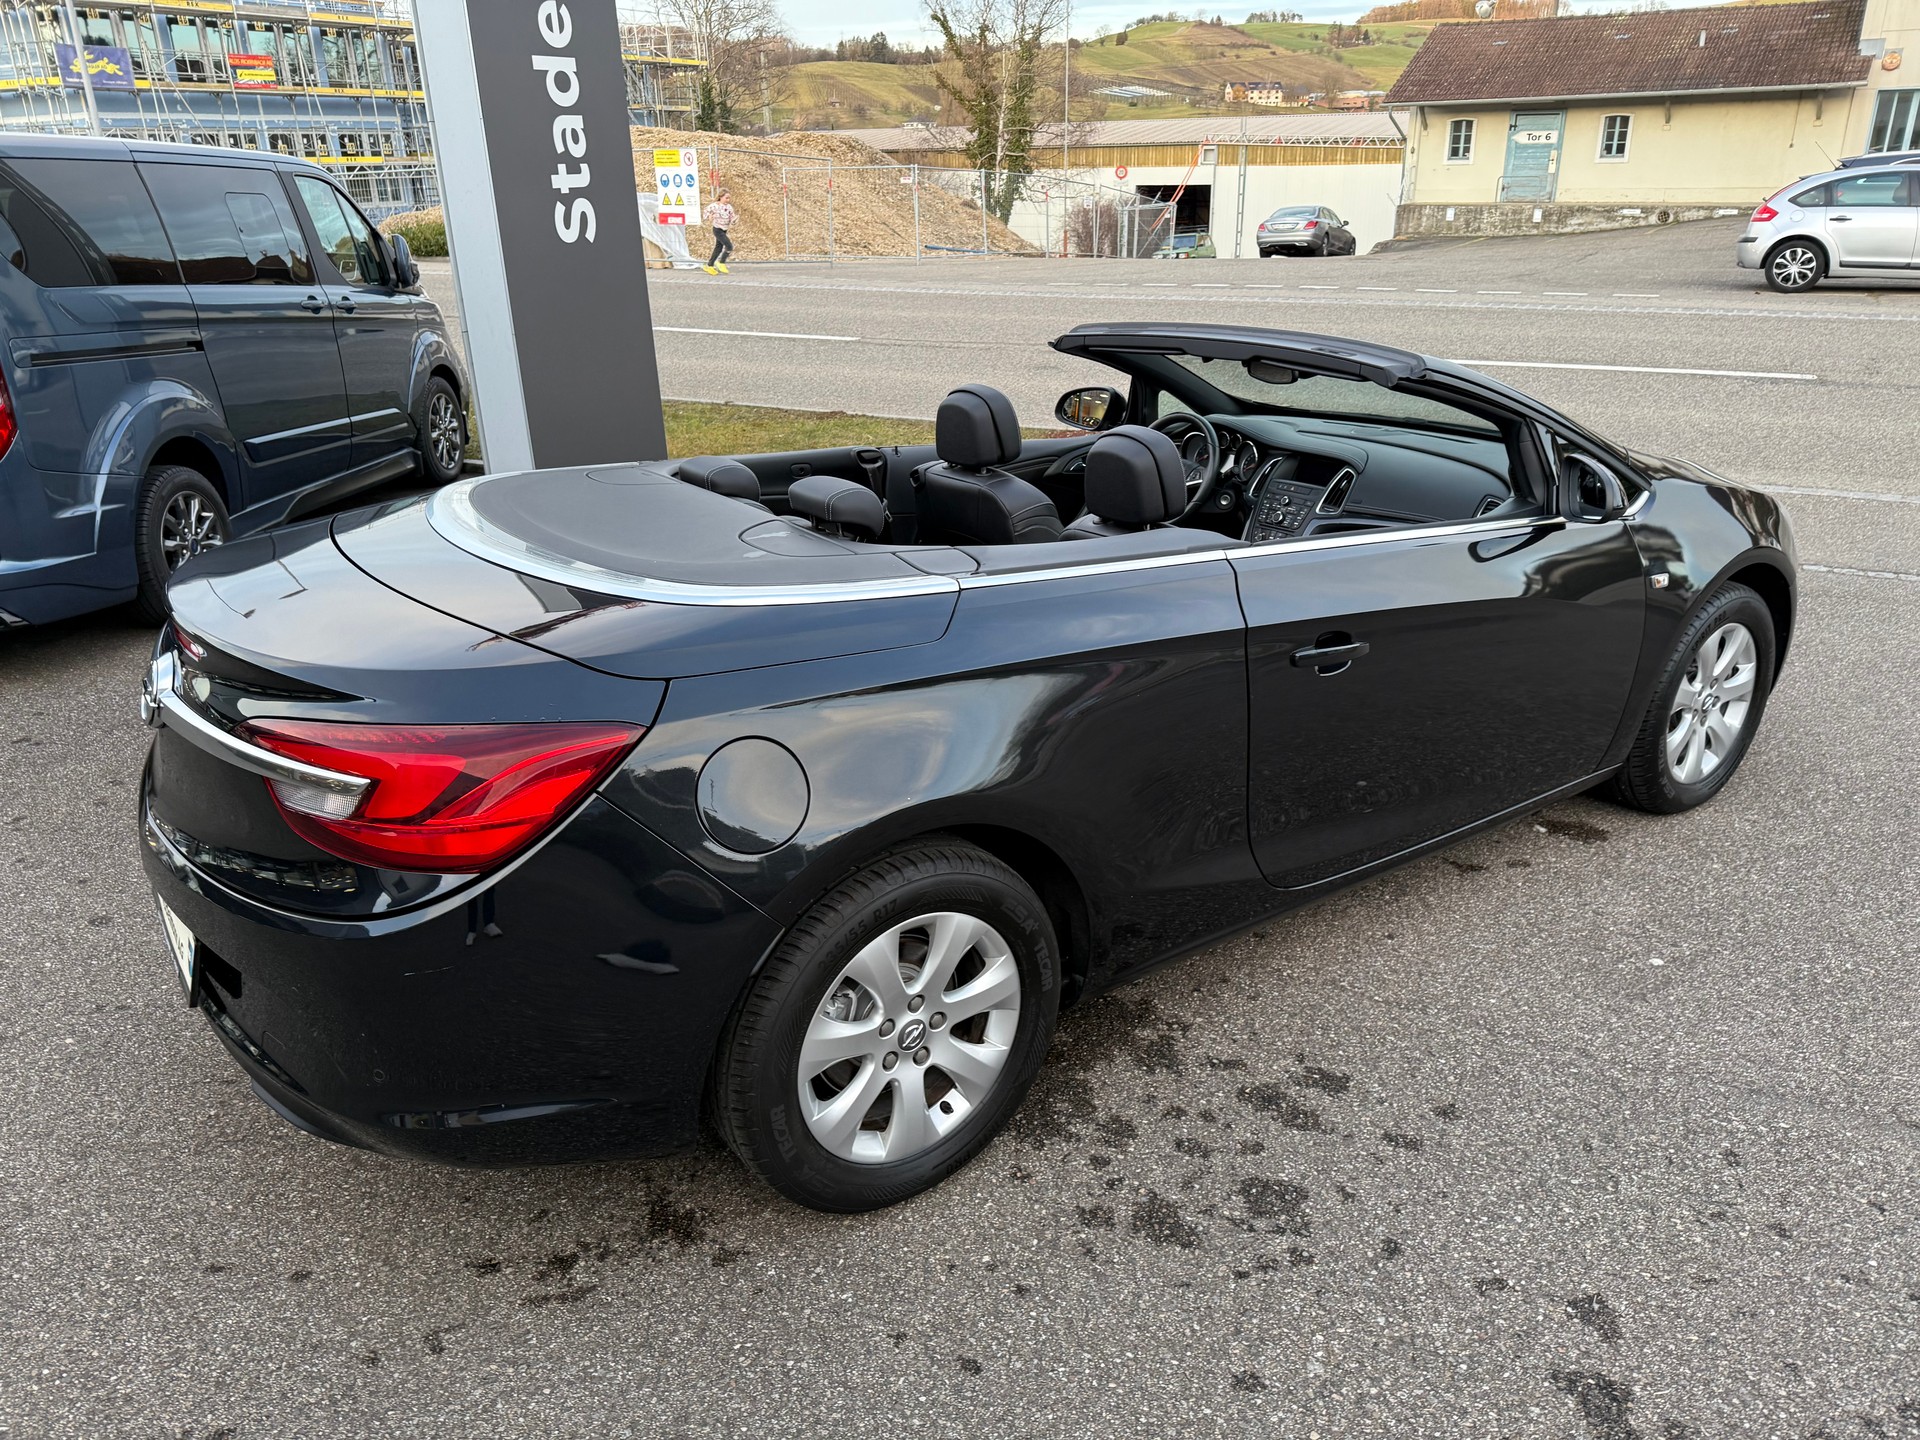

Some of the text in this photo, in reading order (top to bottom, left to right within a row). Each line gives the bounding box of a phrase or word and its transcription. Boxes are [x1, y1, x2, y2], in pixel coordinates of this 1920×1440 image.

[1526, 132, 1552, 141] Tor 6
[872, 898, 899, 923] R17
[1034, 937, 1053, 992] TECAR
[770, 1103, 798, 1163] TECAR
